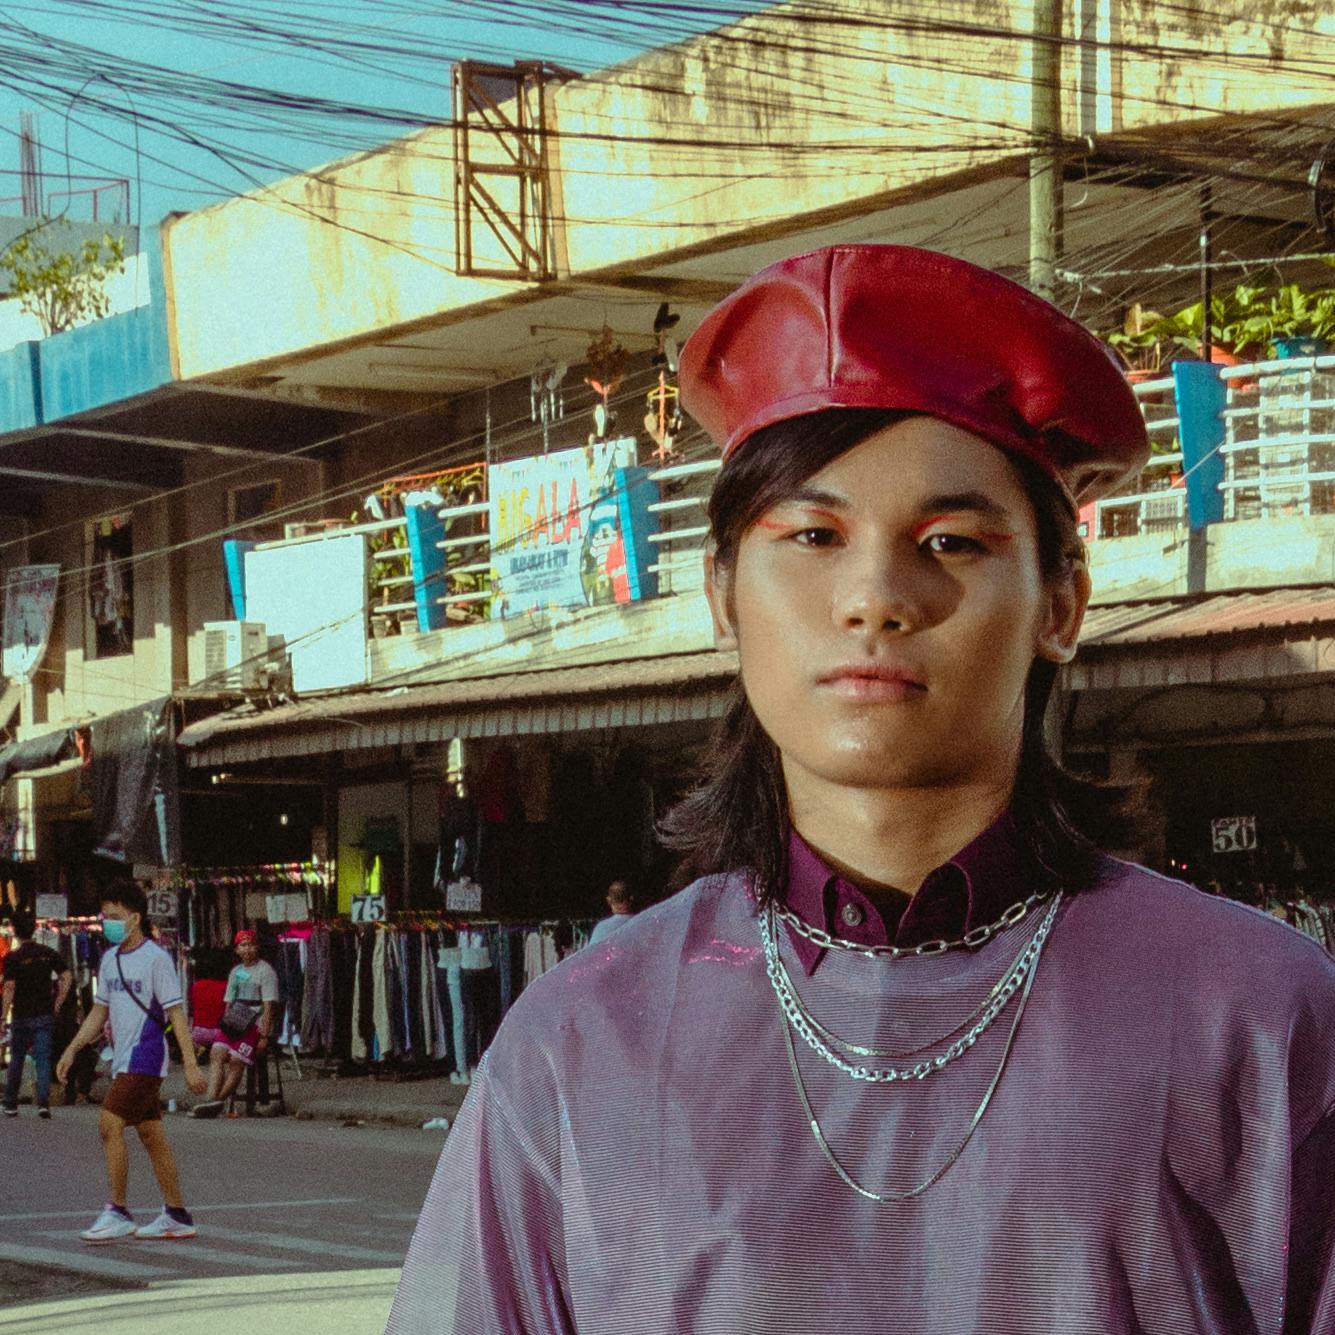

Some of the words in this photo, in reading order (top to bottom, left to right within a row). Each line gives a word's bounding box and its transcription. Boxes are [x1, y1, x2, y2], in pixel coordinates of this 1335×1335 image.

[1214, 819, 1255, 850] 50
[147, 893, 171, 914] 15
[352, 895, 384, 921] 75
